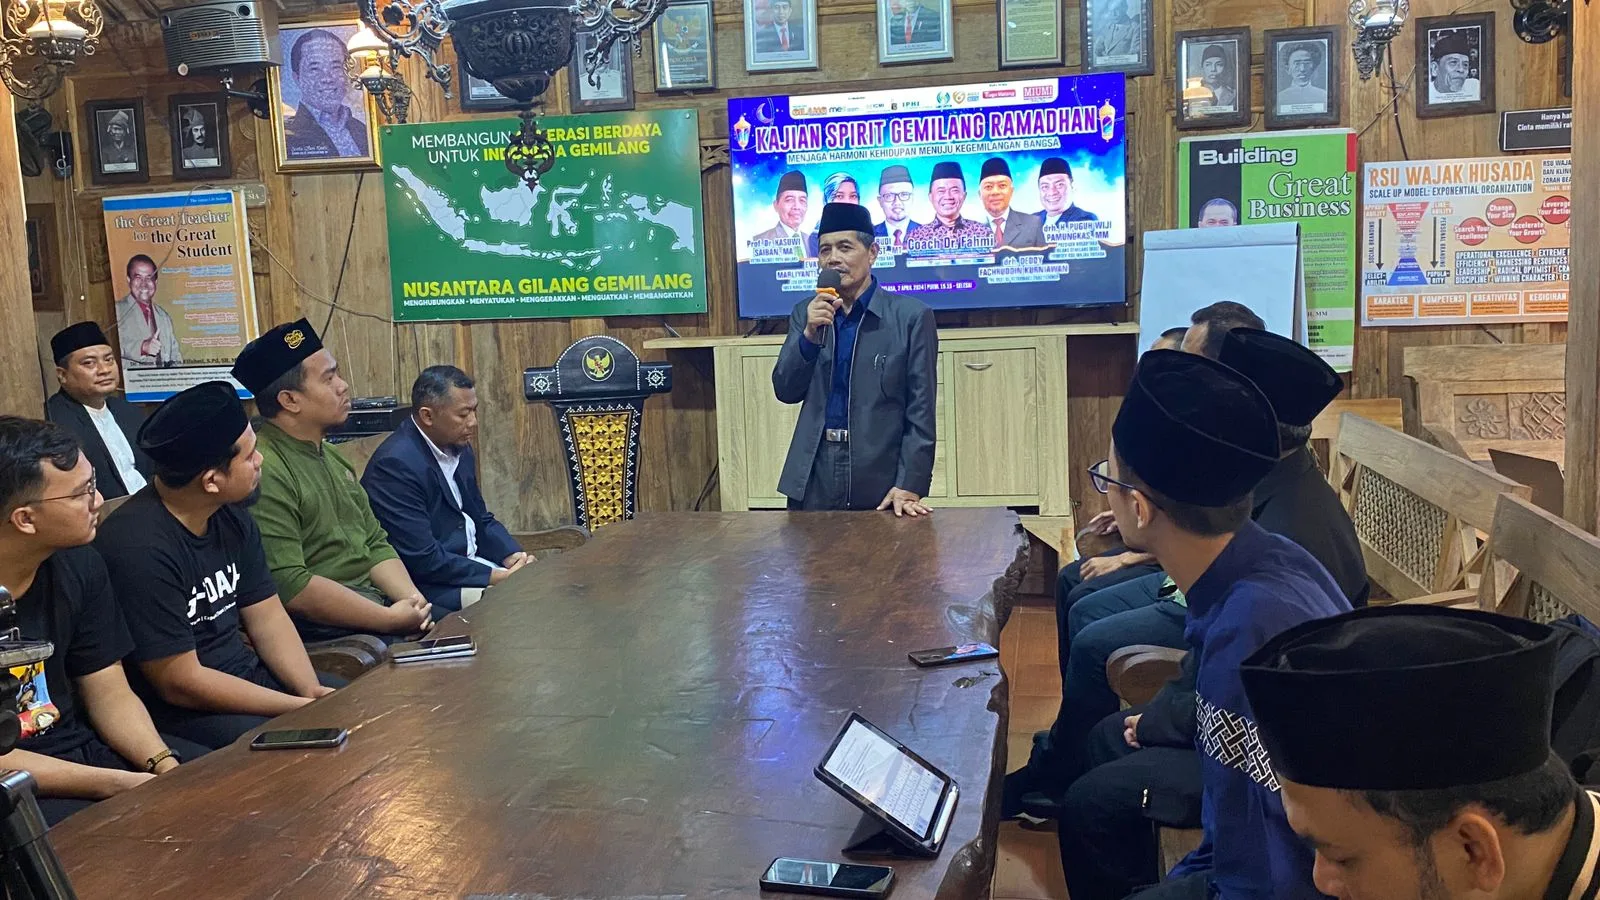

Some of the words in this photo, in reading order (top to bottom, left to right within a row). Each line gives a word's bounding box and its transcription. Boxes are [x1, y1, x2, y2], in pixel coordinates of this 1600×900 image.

[1024, 86, 1052, 96] MIUMI
[411, 131, 511, 149] MEMBANGUN
[593, 123, 662, 140] BERDAYA
[756, 126, 820, 152] KAJIAN
[827, 121, 884, 148] SPIRIT
[891, 115, 983, 144] GEMILANG
[991, 106, 1097, 137] RAMADHAN
[428, 149, 480, 164] UNTUK
[570, 141, 650, 156] GEMILANG
[788, 153, 827, 163] MENJAGA
[831, 151, 868, 160] HARMONI
[870, 149, 915, 158] KEHIDUPAN
[919, 145, 953, 154] MENUJU
[956, 141, 1021, 152] KEGEMILANGAN
[1023, 139, 1059, 148] BANGSA
[1199, 147, 1297, 166] Building
[1370, 168, 1400, 187] RSU
[1406, 164, 1463, 185] WAJAK
[1468, 161, 1533, 183] HUSADA
[1268, 172, 1351, 198] Great
[1370, 189, 1390, 198] SCALE
[1393, 189, 1402, 197] UP
[1404, 188, 1430, 197] MODEL:
[1432, 185, 1479, 196] EXPONENTIAL
[1482, 183, 1532, 193] ORGANIZATION
[1248, 196, 1351, 219] Business
[115, 216, 135, 229] the
[139, 212, 175, 227] Great
[179, 210, 230, 224] Teacher
[1070, 222, 1092, 231] PUGUH
[1095, 221, 1112, 230] WIJI
[133, 230, 147, 241] for
[151, 230, 172, 243] the
[176, 228, 217, 242] Great
[908, 238, 940, 250] Coach
[944, 237, 957, 248] Dr.
[961, 236, 995, 247] Fahmi
[177, 244, 232, 258] Student
[1456, 251, 1494, 259] OPERATIONAL
[1539, 248, 1566, 256] EXTREME
[1020, 256, 1042, 265] DEDDY
[1496, 258, 1532, 266] HARNESSING
[980, 267, 1022, 276] FACHRUDDIN
[1025, 265, 1067, 273] KURNIAWAN
[403, 279, 515, 298] NUSANTARA
[518, 277, 589, 295] GILANG
[593, 273, 694, 292] GEMILANG
[404, 298, 465, 306] MENGHUBUNGKAN
[520, 295, 576, 303] MENGGERAKKAN
[633, 291, 694, 300] MEMBANGKITKAN
[1374, 296, 1408, 304] KARAKTER
[1422, 295, 1464, 303] KOMPETENSI
[1474, 293, 1517, 302] KREATIVITAS
